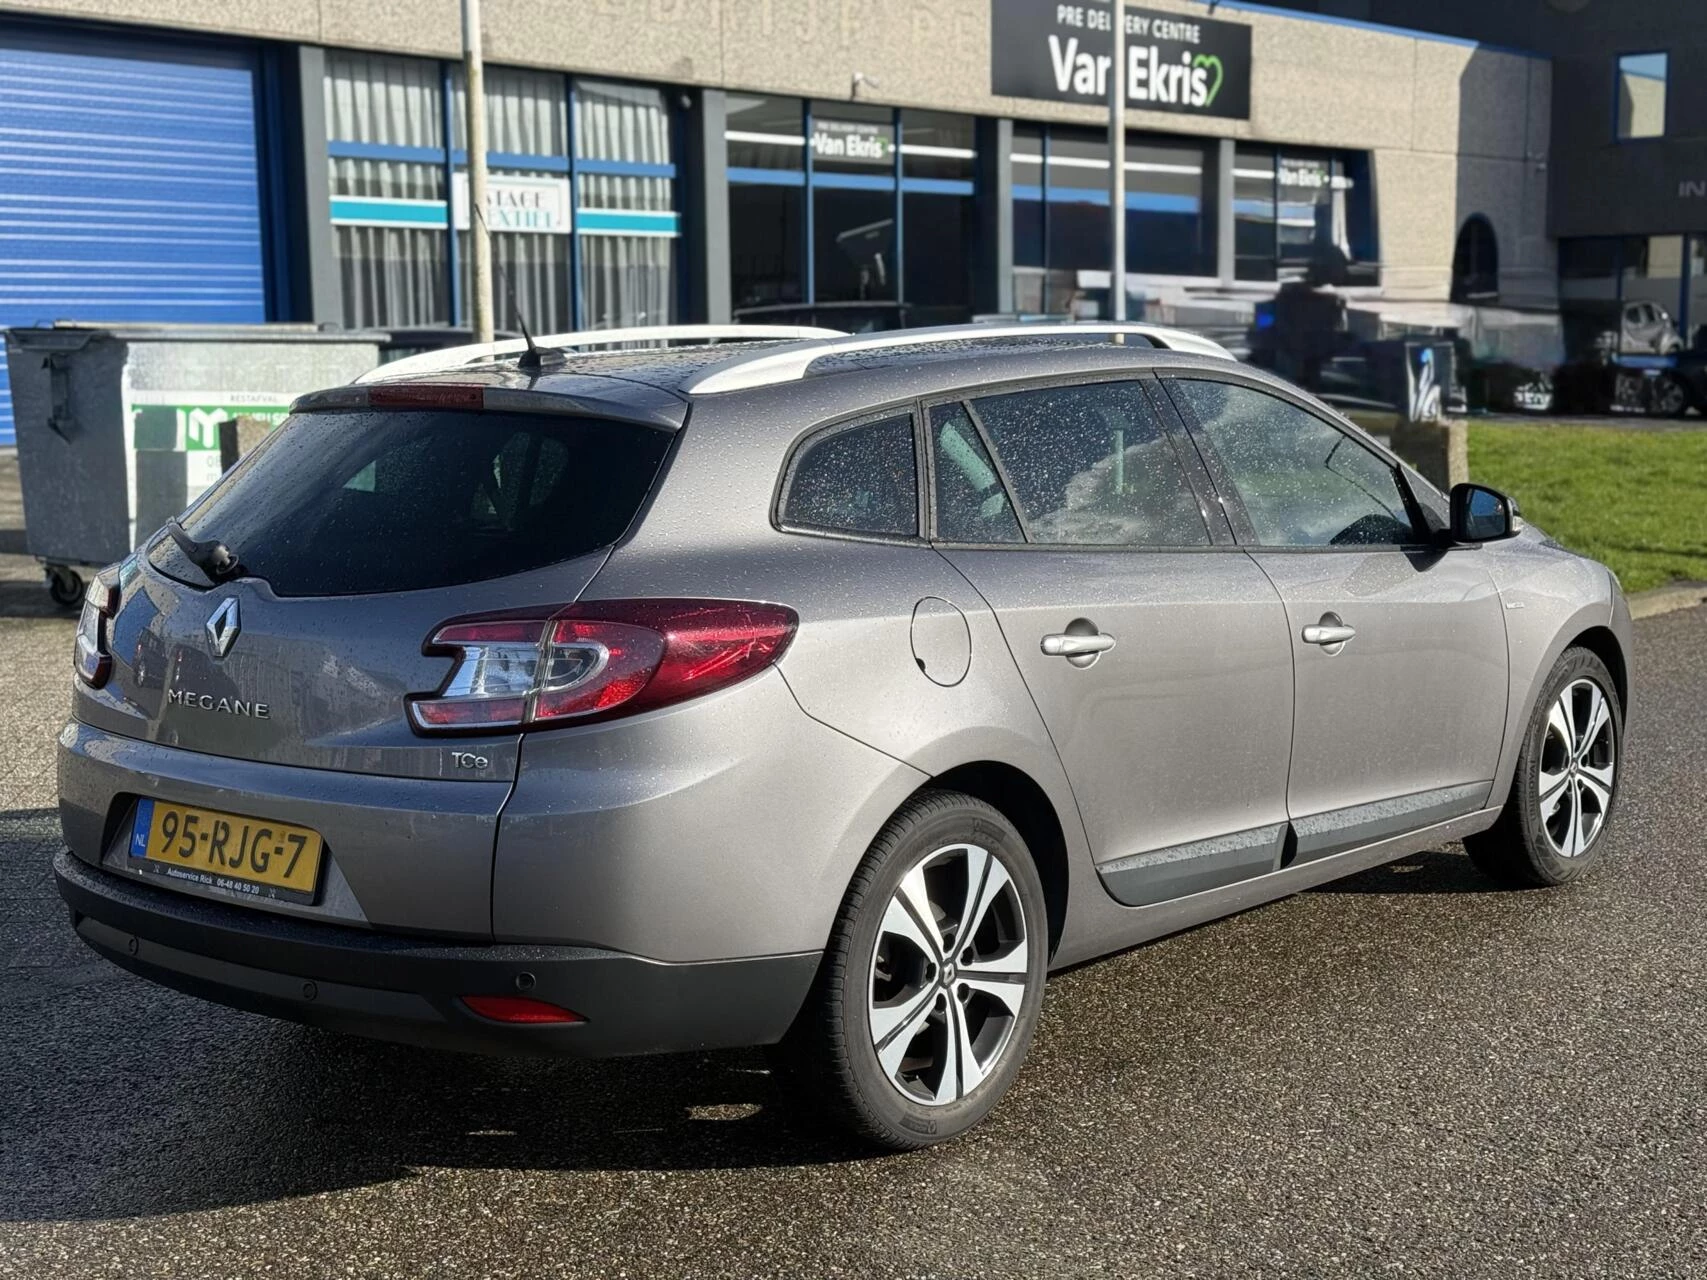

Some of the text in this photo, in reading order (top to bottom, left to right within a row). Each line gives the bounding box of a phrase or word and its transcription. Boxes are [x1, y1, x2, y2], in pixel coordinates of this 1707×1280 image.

[1057, 4, 1201, 44] PRE DELERY CENTRE
[1127, 45, 1209, 107] Ekris
[814, 132, 882, 158] Van Ekris
[486, 208, 554, 229] EXTIEL
[168, 688, 271, 719] MEGANE
[451, 751, 488, 769] TCe
[135, 832, 147, 848] NL
[161, 810, 308, 879] 95-RJG-7
[166, 867, 260, 895] Autoservice Rick 06-48 40 50 20
